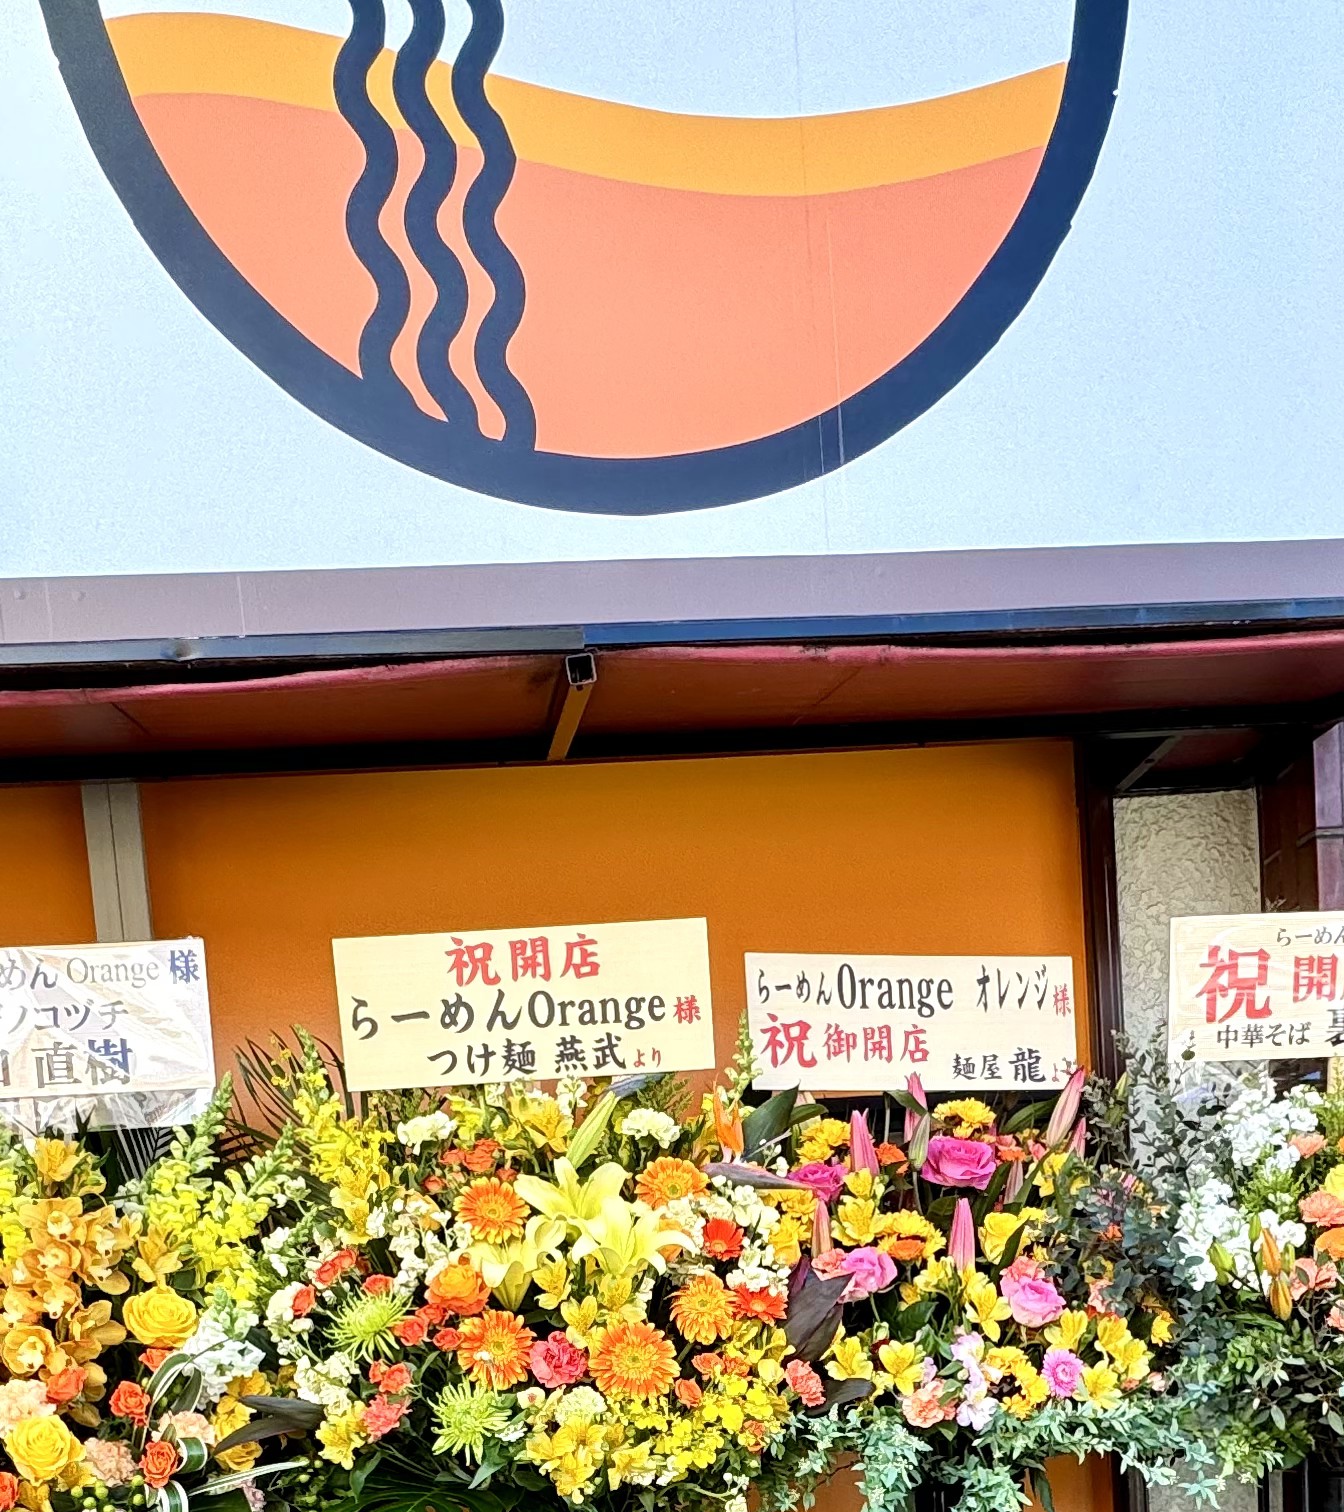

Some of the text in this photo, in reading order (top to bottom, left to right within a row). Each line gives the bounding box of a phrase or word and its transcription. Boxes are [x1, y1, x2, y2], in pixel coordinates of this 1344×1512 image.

[66, 954, 161, 990] Orange
[167, 949, 202, 986] 様
[444, 932, 603, 988] 祝開店
[427, 1038, 538, 1077] つけ麺
